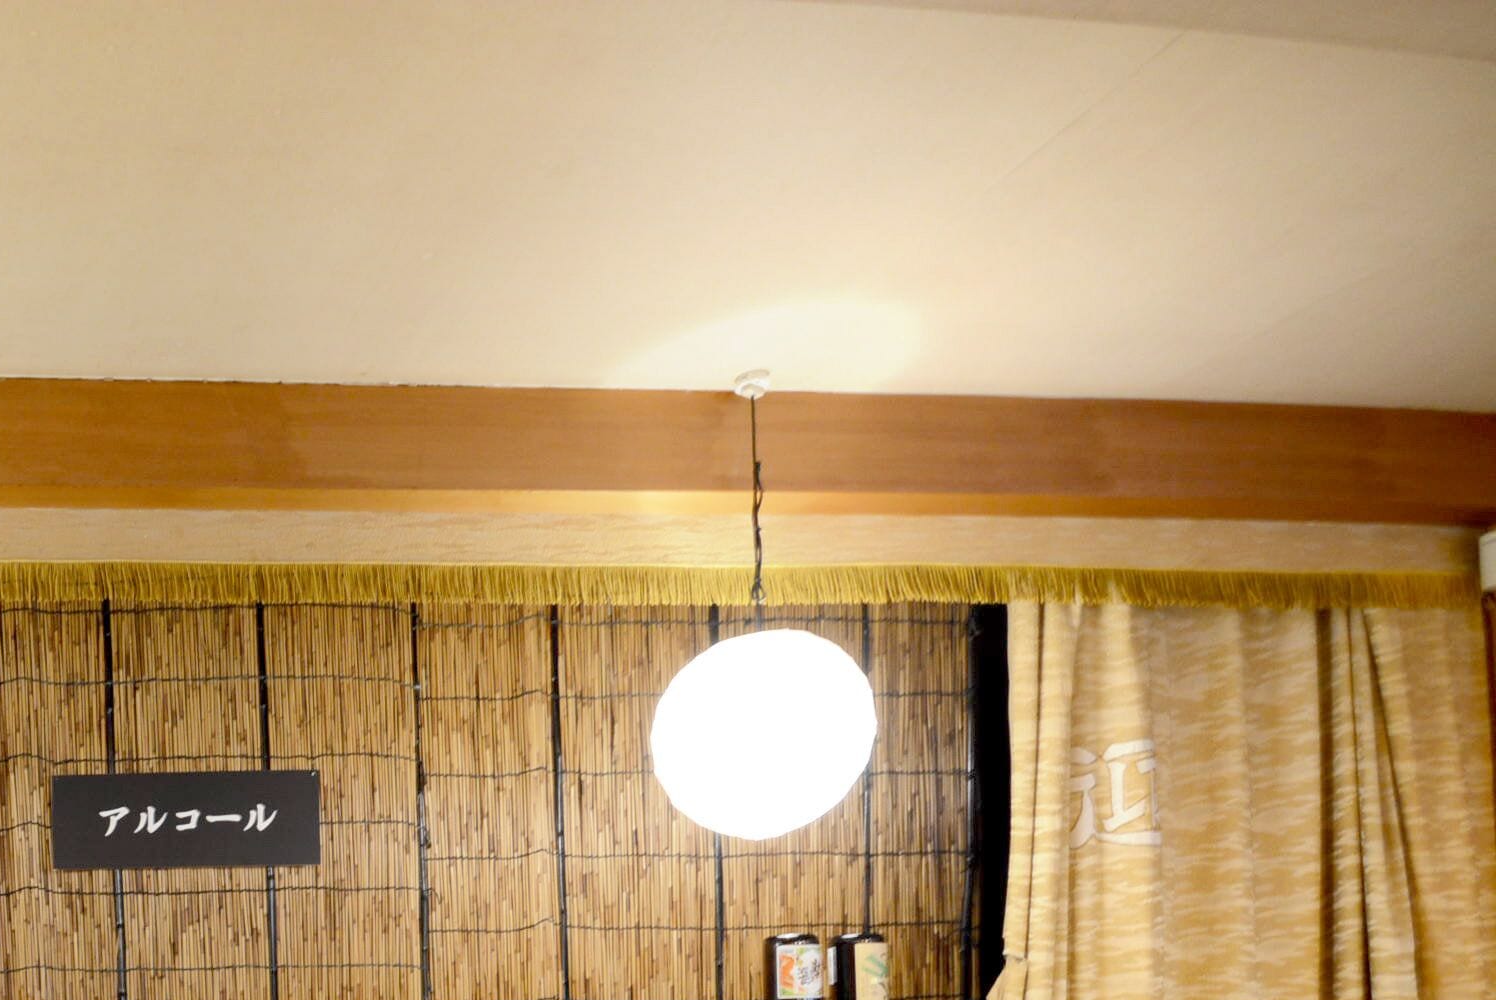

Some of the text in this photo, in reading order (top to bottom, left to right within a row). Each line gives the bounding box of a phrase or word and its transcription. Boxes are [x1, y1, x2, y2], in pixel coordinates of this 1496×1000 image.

[98, 803, 278, 837] アルコール
